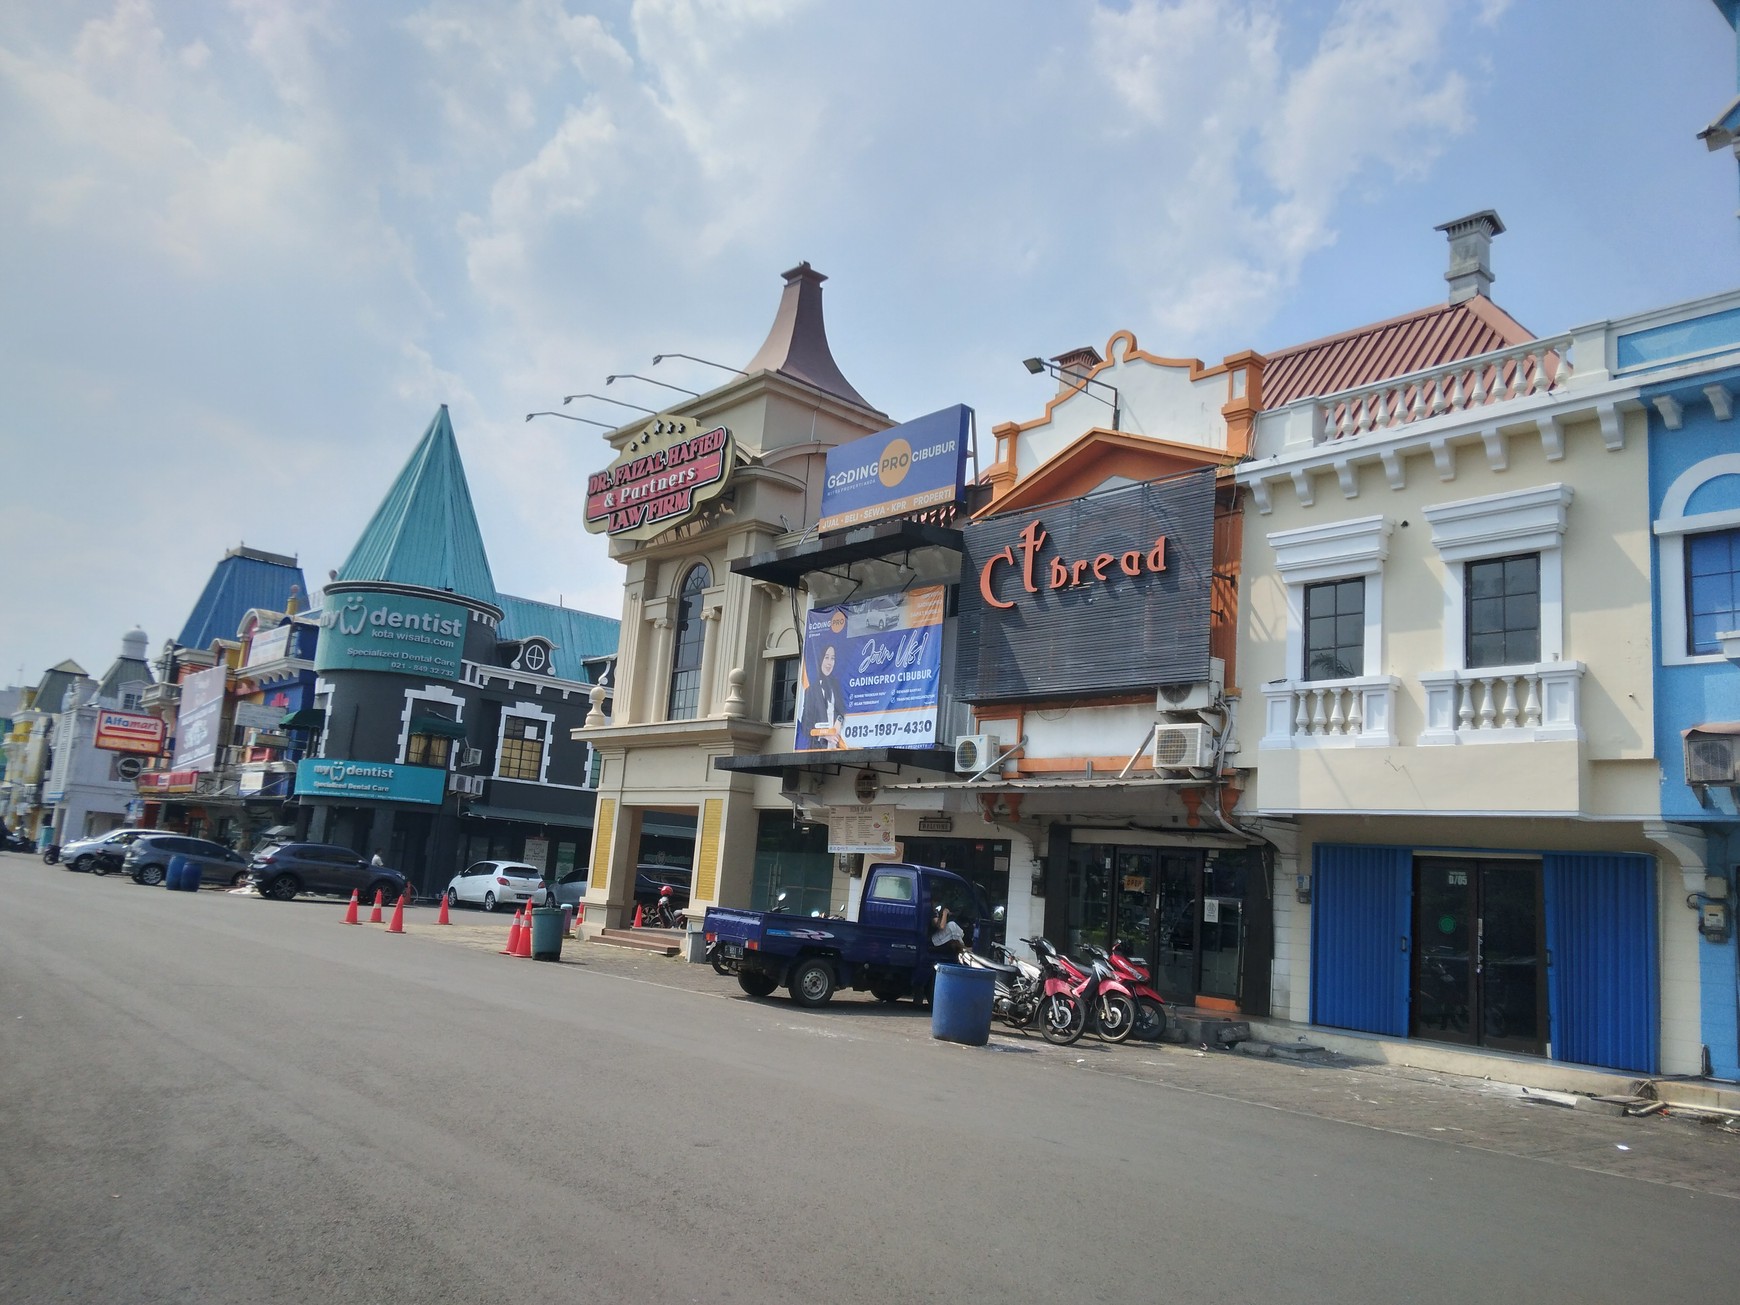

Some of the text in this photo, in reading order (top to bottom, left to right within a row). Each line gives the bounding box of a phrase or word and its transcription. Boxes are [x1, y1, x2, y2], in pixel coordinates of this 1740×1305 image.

[881, 453, 909, 472] PRO
[911, 440, 956, 462] CIBUBUR
[589, 472, 612, 495] DR.
[614, 452, 665, 486] FAIZAL
[604, 467, 697, 508] & Partners
[608, 490, 690, 532] LAW FIRM
[822, 490, 951, 529] JUAL BELI SEWA KPR PROPERTI
[1049, 535, 1167, 589] bread
[320, 606, 462, 637] my dentist
[372, 629, 454, 648] kota wisata.com
[347, 647, 455, 667] Specialized Dental Care
[859, 630, 929, 673] Join Us!
[391, 661, 406, 669] 021
[849, 669, 932, 688] GADINGPRO CIBUBUR
[105, 716, 159, 730] Alfamart
[845, 720, 932, 738] 0813-1987-4330
[346, 765, 394, 778] dentist
[348, 783, 370, 791] Dental
[372, 784, 389, 792] Care
